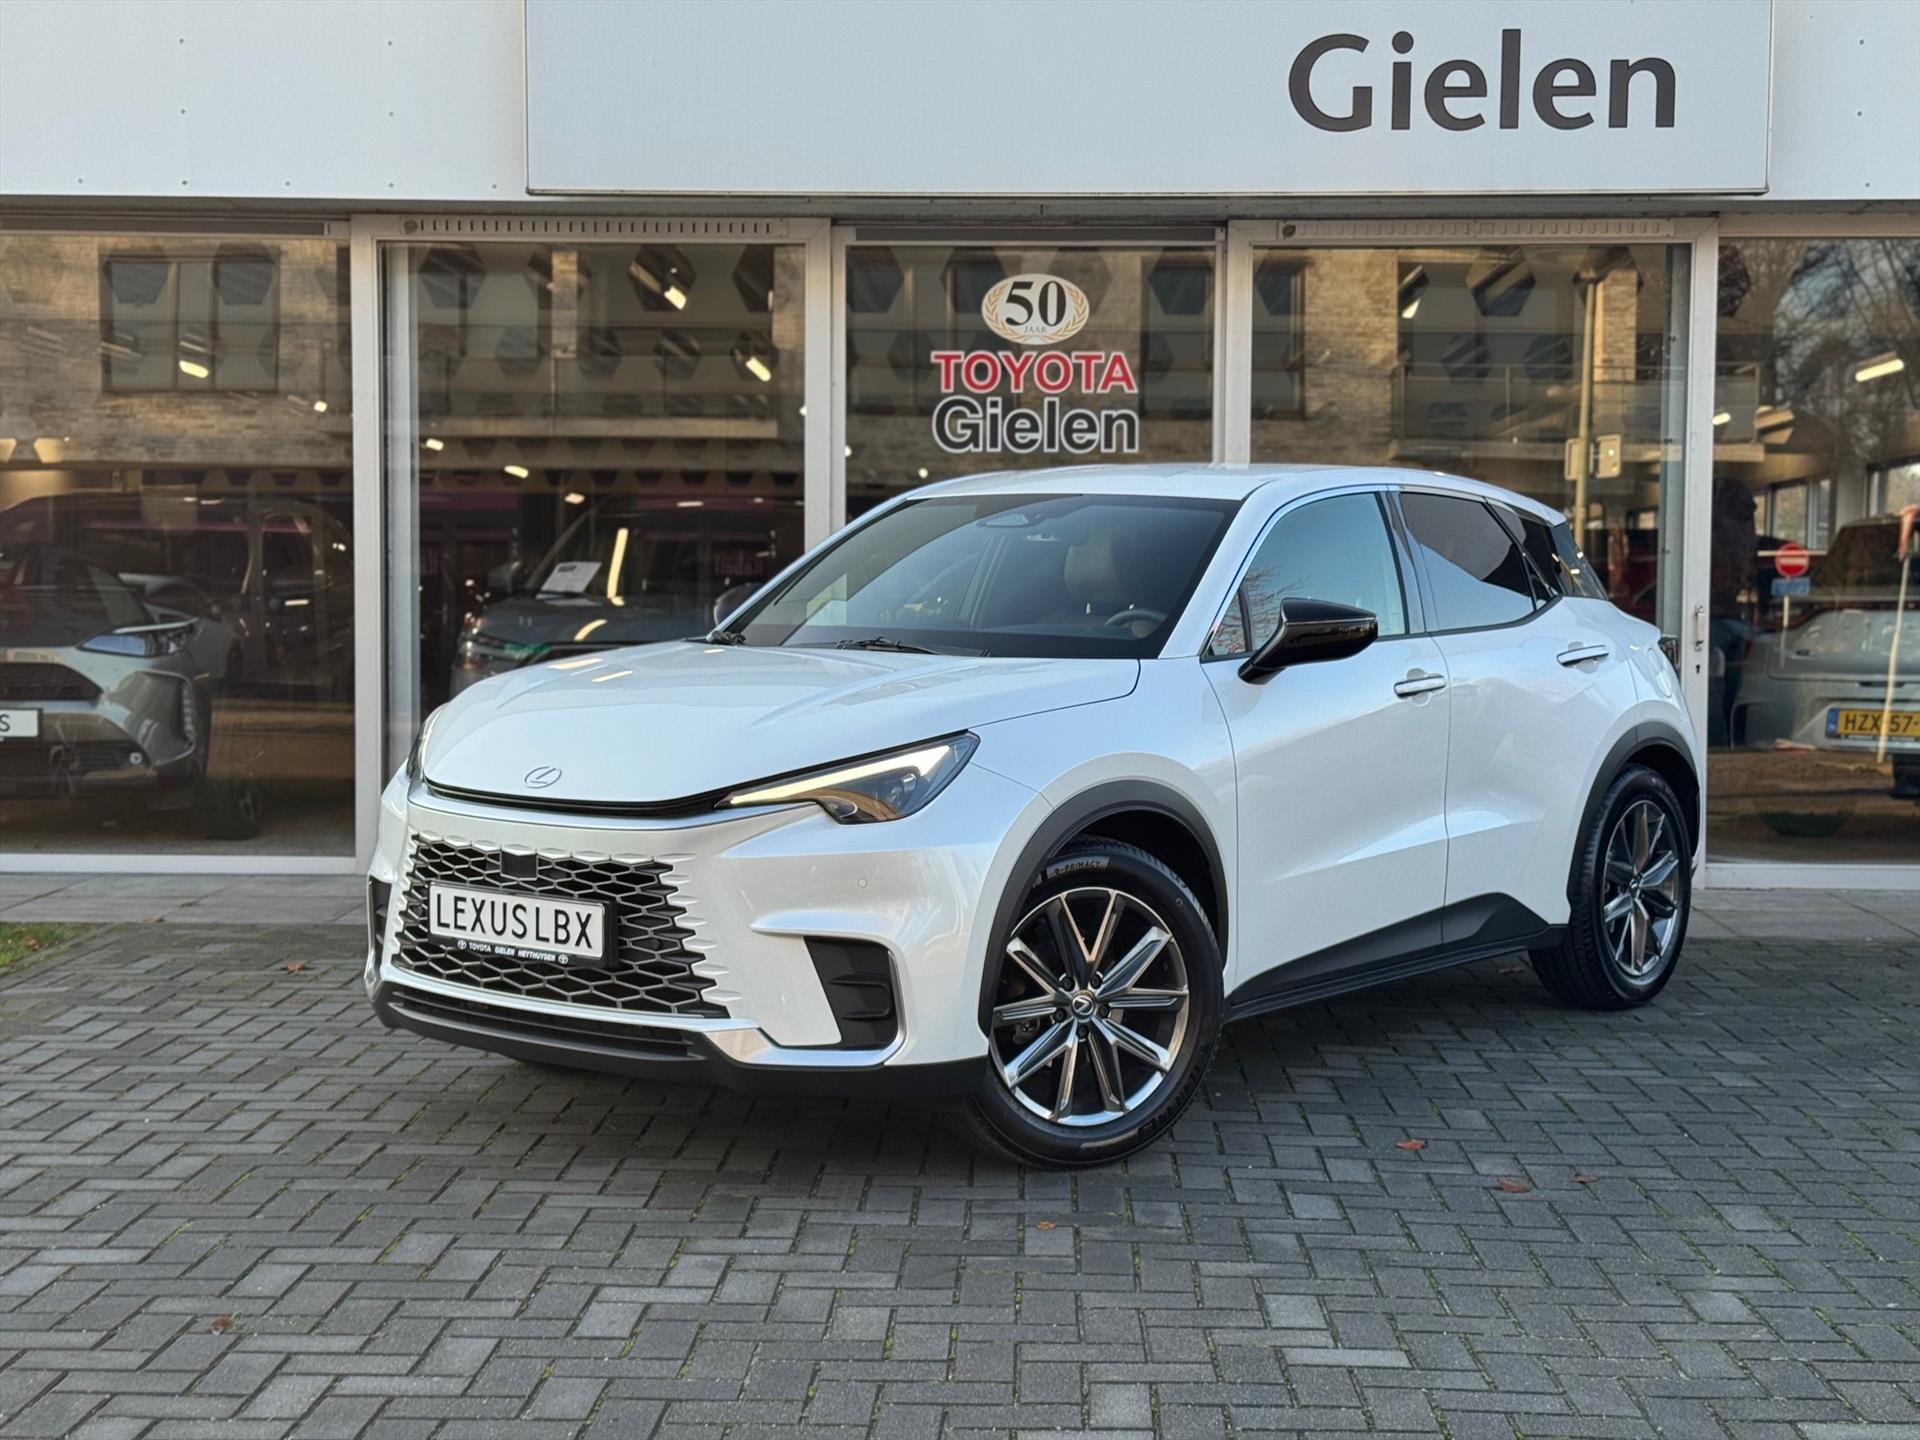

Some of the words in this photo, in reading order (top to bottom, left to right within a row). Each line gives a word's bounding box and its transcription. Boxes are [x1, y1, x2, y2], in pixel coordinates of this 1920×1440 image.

[1288, 28, 1676, 133] Gielen
[1005, 280, 1067, 327] 50
[1024, 325, 1047, 334] JAAR
[931, 351, 1139, 394] TOYOTA
[932, 395, 1140, 454] Gielen
[1844, 712, 1920, 733] HZX57-
[468, 942, 492, 953] TOYOTA
